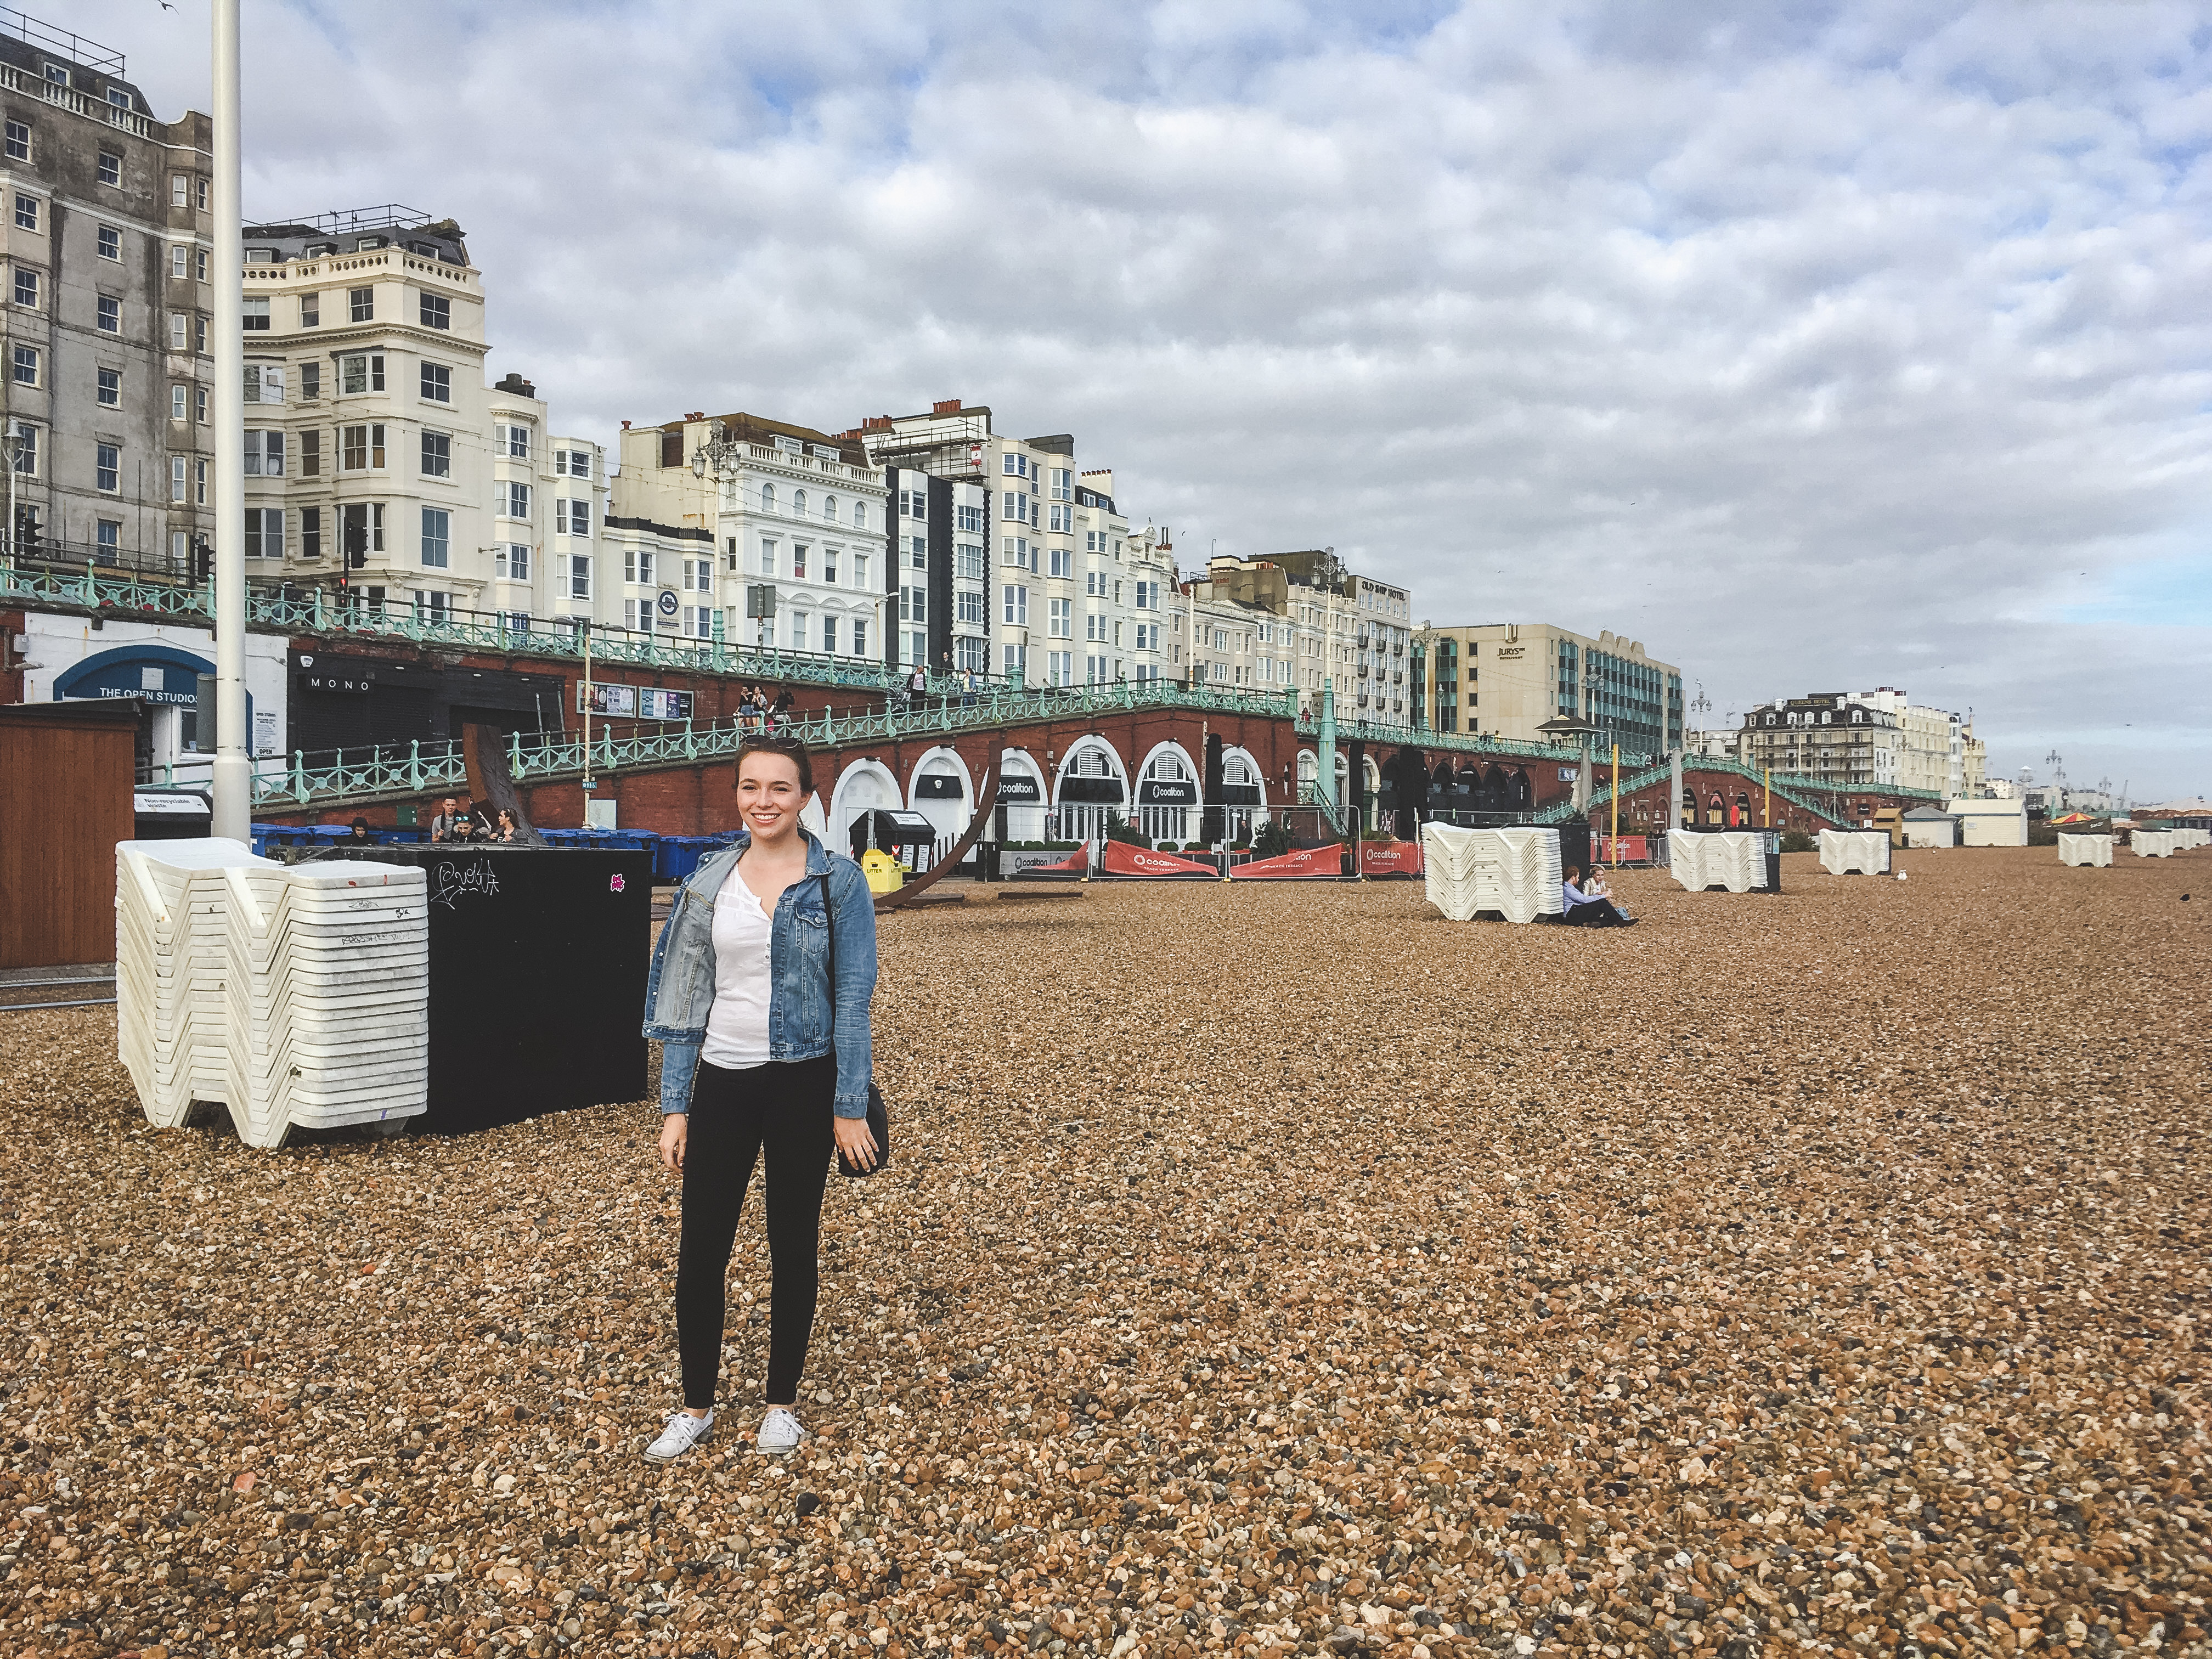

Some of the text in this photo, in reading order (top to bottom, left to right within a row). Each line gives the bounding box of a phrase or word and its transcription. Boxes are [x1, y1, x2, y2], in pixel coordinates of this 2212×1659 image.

[1362, 581, 1374, 591] OLD
[1388, 588, 1406, 601] HOTEL
[1497, 647, 1519, 656] JURYS
[311, 678, 369, 691] MONO
[99, 687, 121, 698] THE
[124, 689, 153, 701] OPEN
[1003, 783, 1033, 793] coalition
[1160, 787, 1184, 796] coalition
[1022, 857, 1048, 866] coalition
